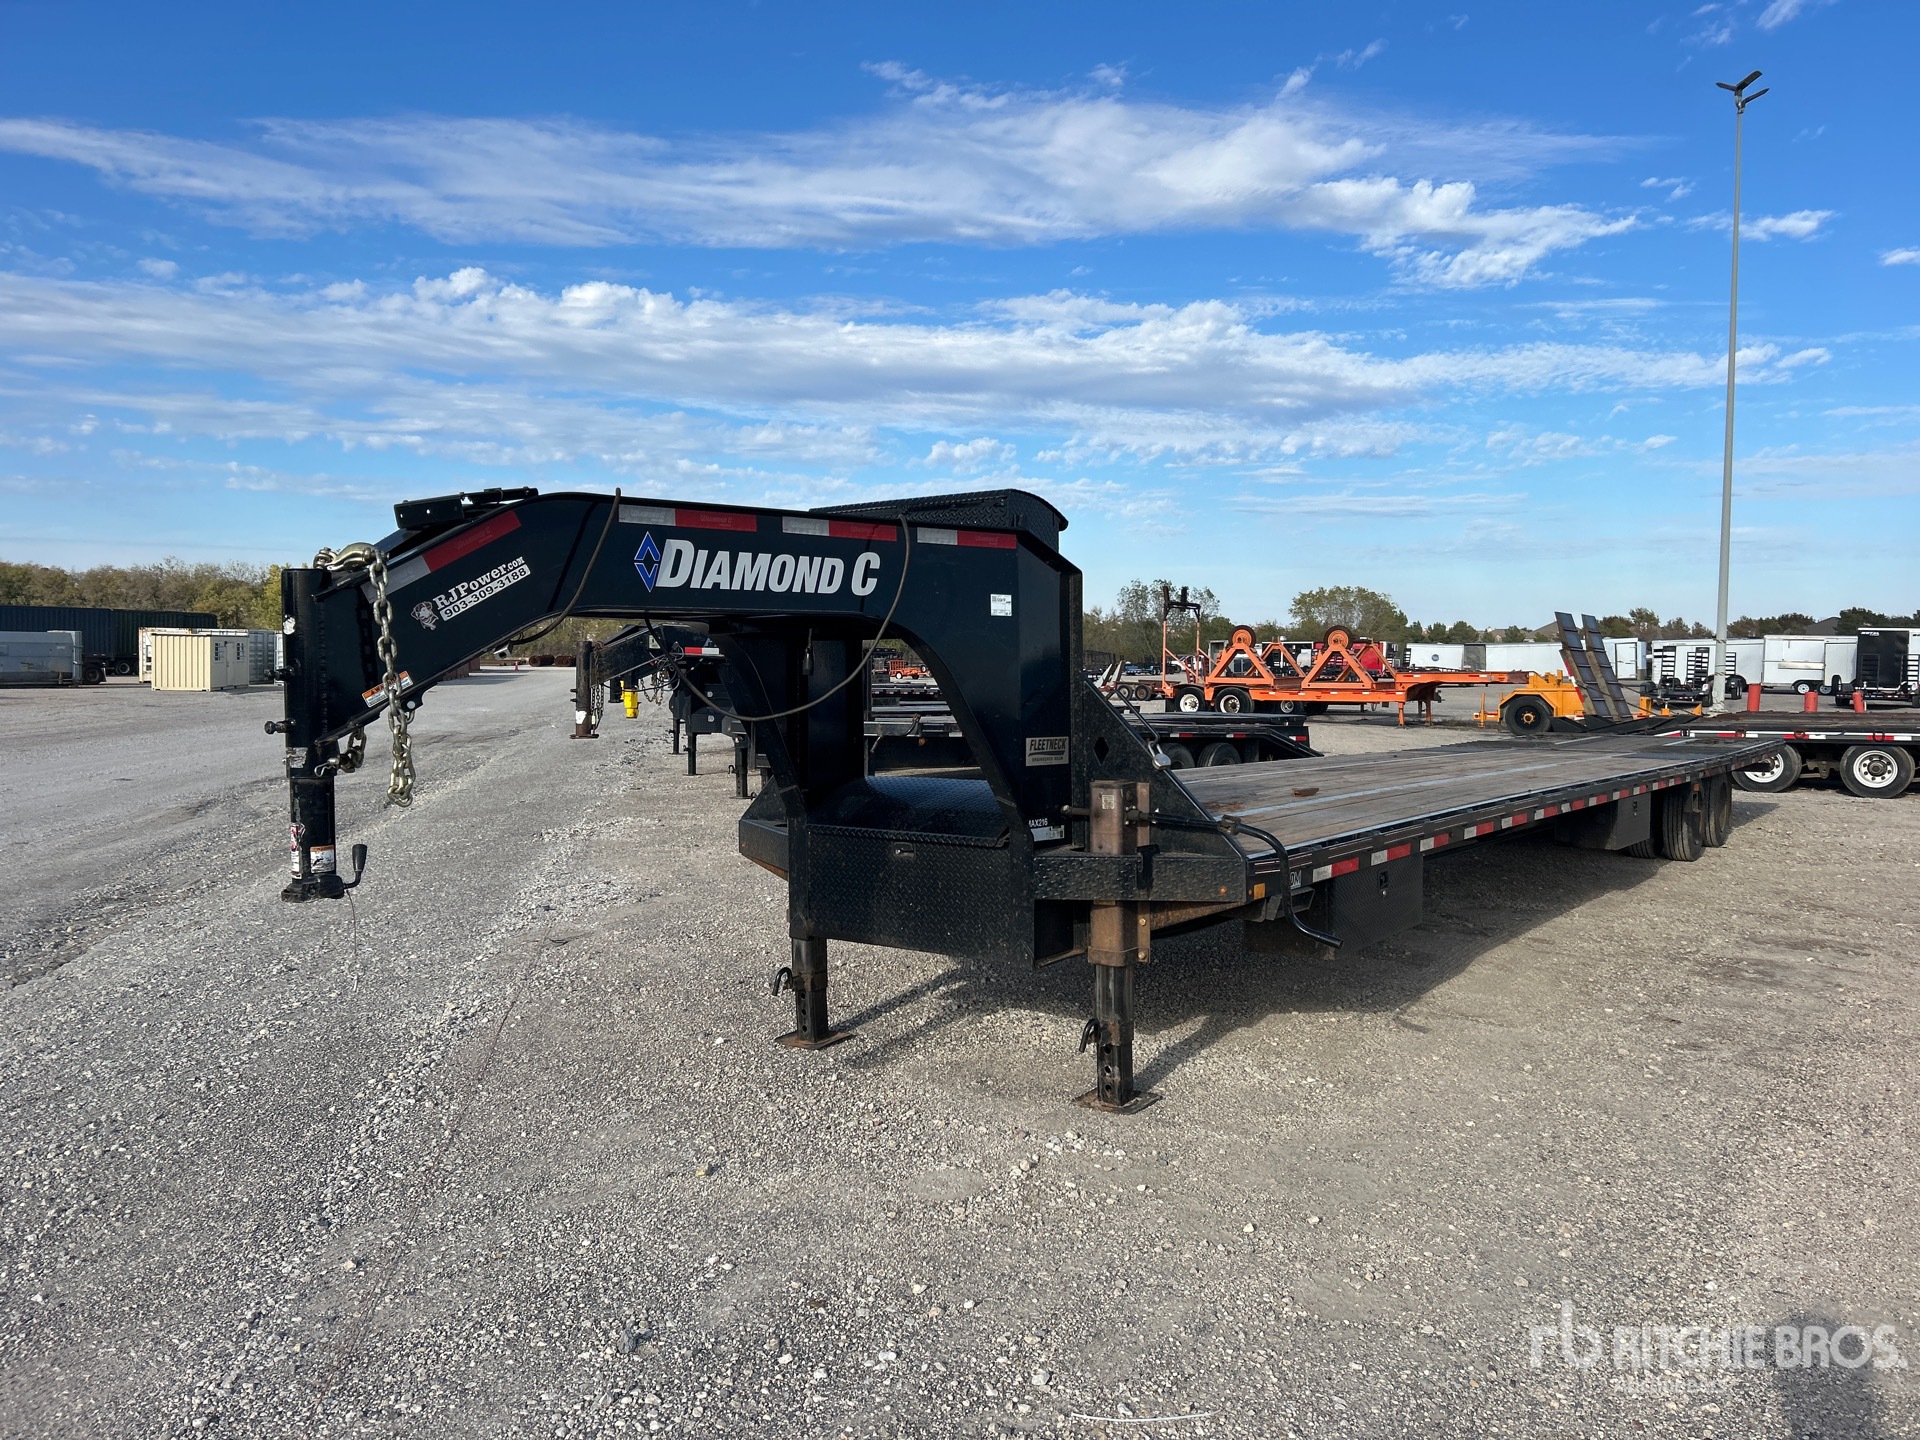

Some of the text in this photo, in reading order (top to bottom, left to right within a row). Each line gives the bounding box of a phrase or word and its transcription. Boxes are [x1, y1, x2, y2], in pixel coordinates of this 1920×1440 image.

[444, 567, 527, 618] 903-309-3188
[656, 538, 881, 596] DIAMOND C
[1029, 738, 1067, 751] FLEETNECK
